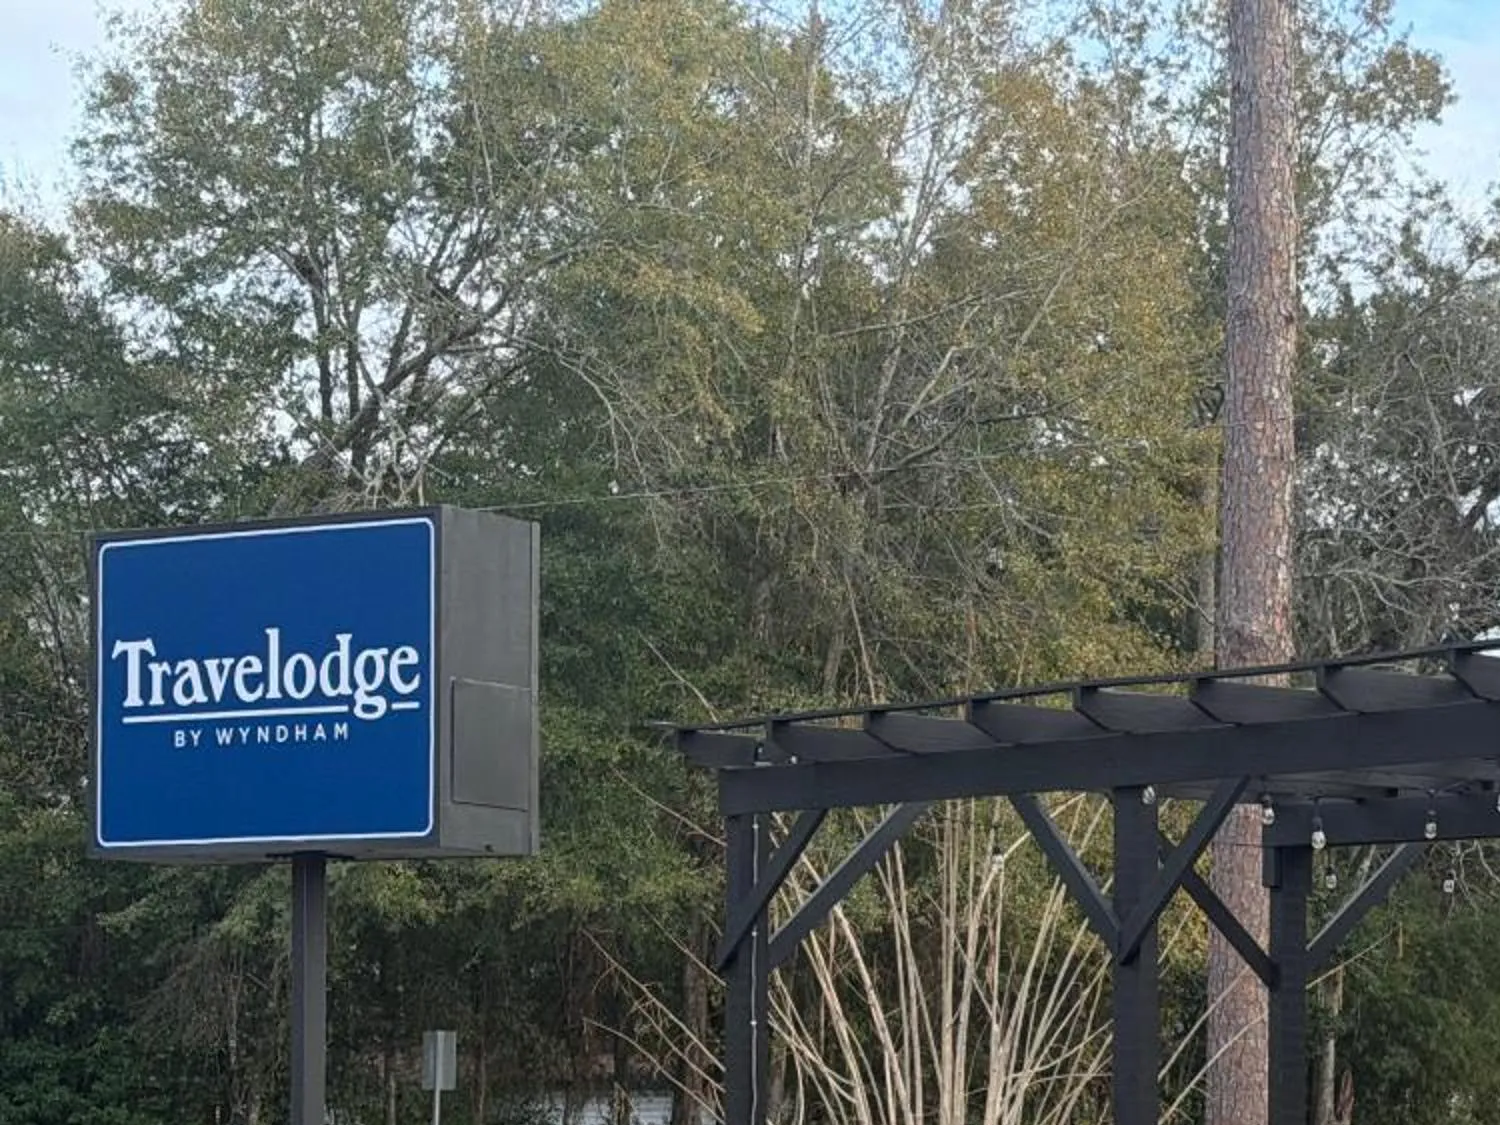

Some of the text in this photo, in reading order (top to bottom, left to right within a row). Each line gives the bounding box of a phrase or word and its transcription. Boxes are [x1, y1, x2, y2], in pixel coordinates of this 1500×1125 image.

[112, 627, 421, 720] Travelodge
[174, 722, 349, 748] BY WYNDHAM
